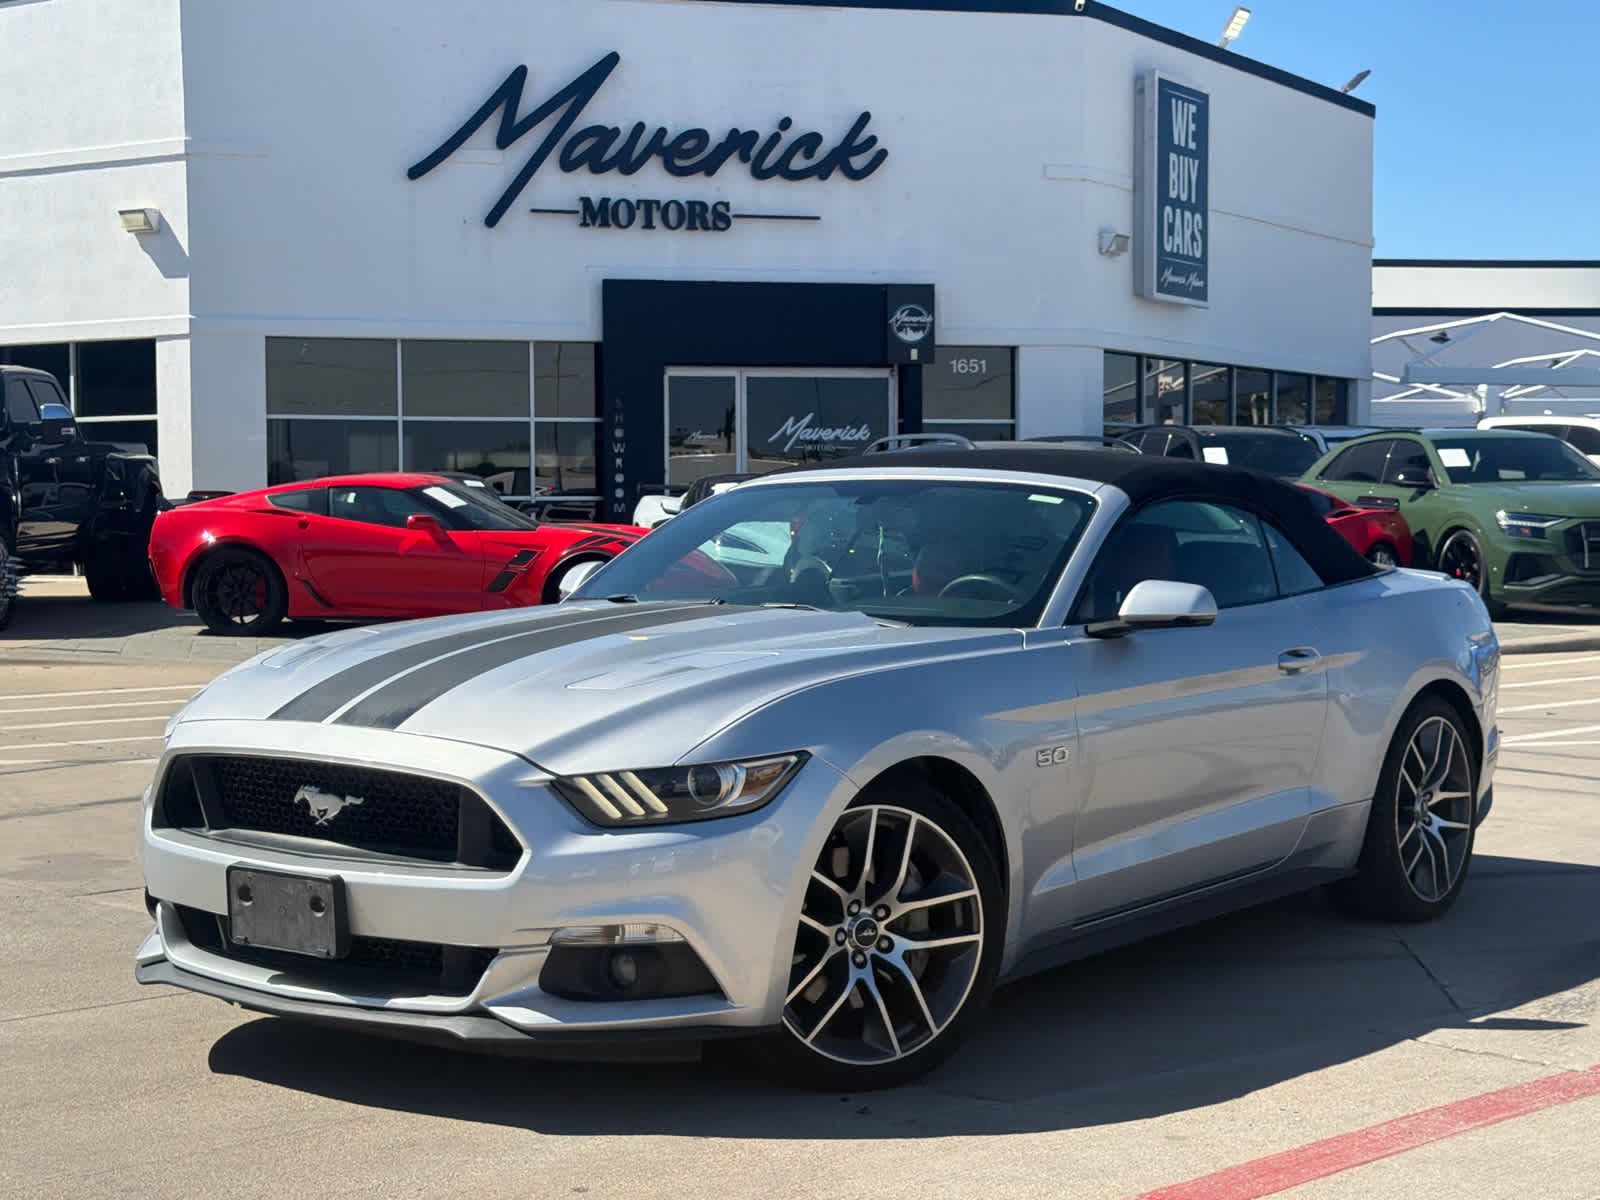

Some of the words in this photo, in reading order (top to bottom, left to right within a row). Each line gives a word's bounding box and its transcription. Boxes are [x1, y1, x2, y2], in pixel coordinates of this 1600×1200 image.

[407, 51, 888, 228] Maverick
[1171, 98, 1197, 150] WE
[1169, 152, 1199, 204] BUY
[579, 197, 732, 231] MOTORS
[1163, 205, 1203, 258] CARS
[949, 359, 986, 374] 1651
[768, 412, 871, 452] Maverick
